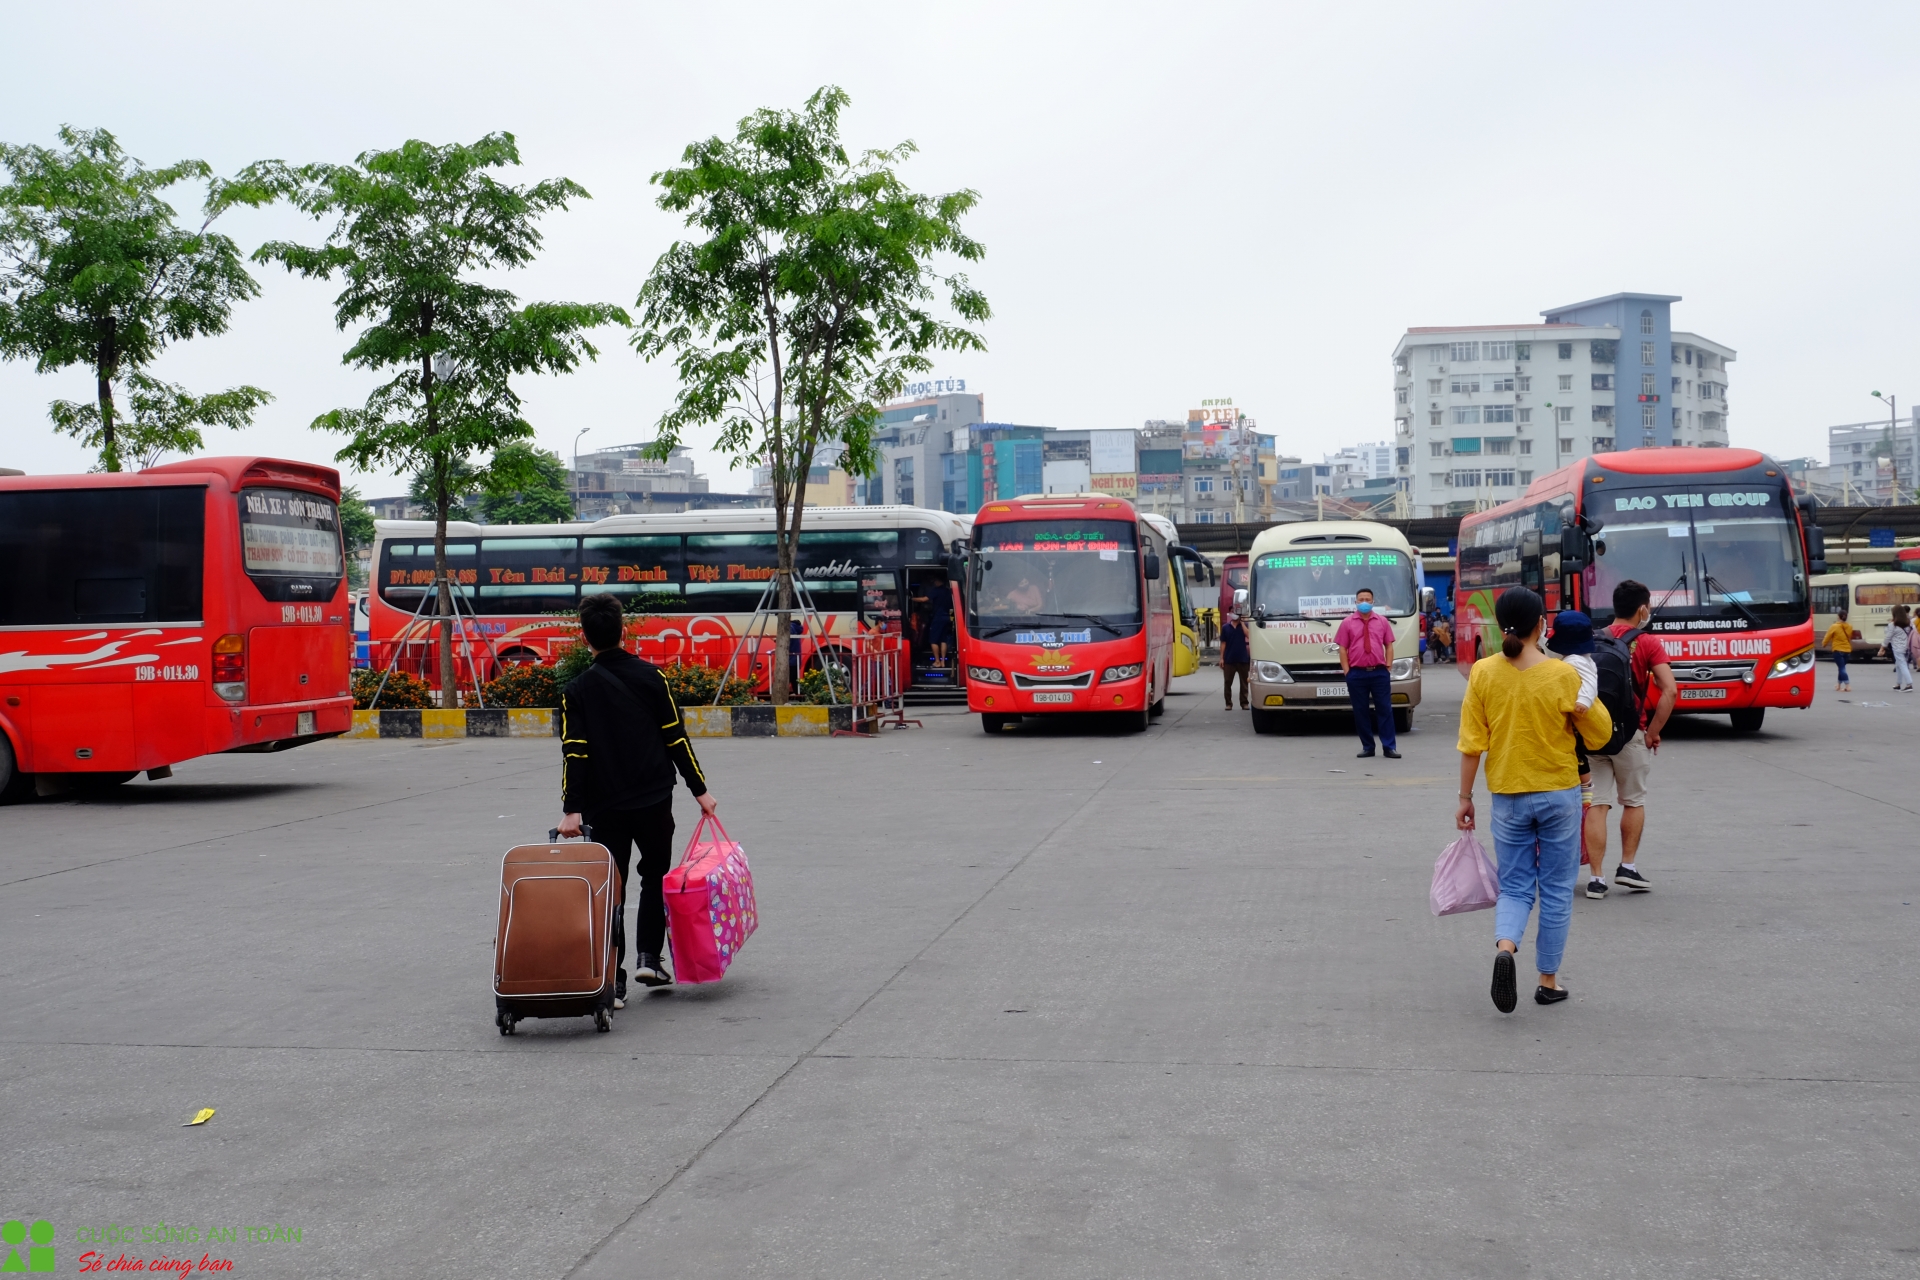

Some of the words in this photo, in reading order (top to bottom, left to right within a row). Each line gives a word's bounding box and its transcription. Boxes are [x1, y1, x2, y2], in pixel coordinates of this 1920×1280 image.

[1091, 475, 1114, 489] NGHỈ
[1116, 478, 1135, 490] TRỌ
[246, 493, 269, 514] NHÀ
[1615, 496, 1657, 511] BAO
[1662, 494, 1704, 508] YEN
[1708, 493, 1770, 507] GROUP
[1268, 556, 1306, 568] THANH
[1310, 554, 1334, 566] SƠN
[1346, 552, 1363, 565] MỸ
[1369, 552, 1397, 565] ĐÌNH
[489, 568, 525, 583] Yên
[531, 567, 566, 583] Bái
[580, 566, 610, 585] Mỹ
[617, 564, 668, 581] Đình
[688, 565, 720, 583] Việt
[727, 564, 781, 580] Phươn
[1652, 622, 1662, 630] XE
[1664, 621, 1685, 630] CHẠY
[1715, 620, 1731, 628] CAO
[1730, 639, 1771, 656] QUANG
[135, 666, 155, 681] 19B
